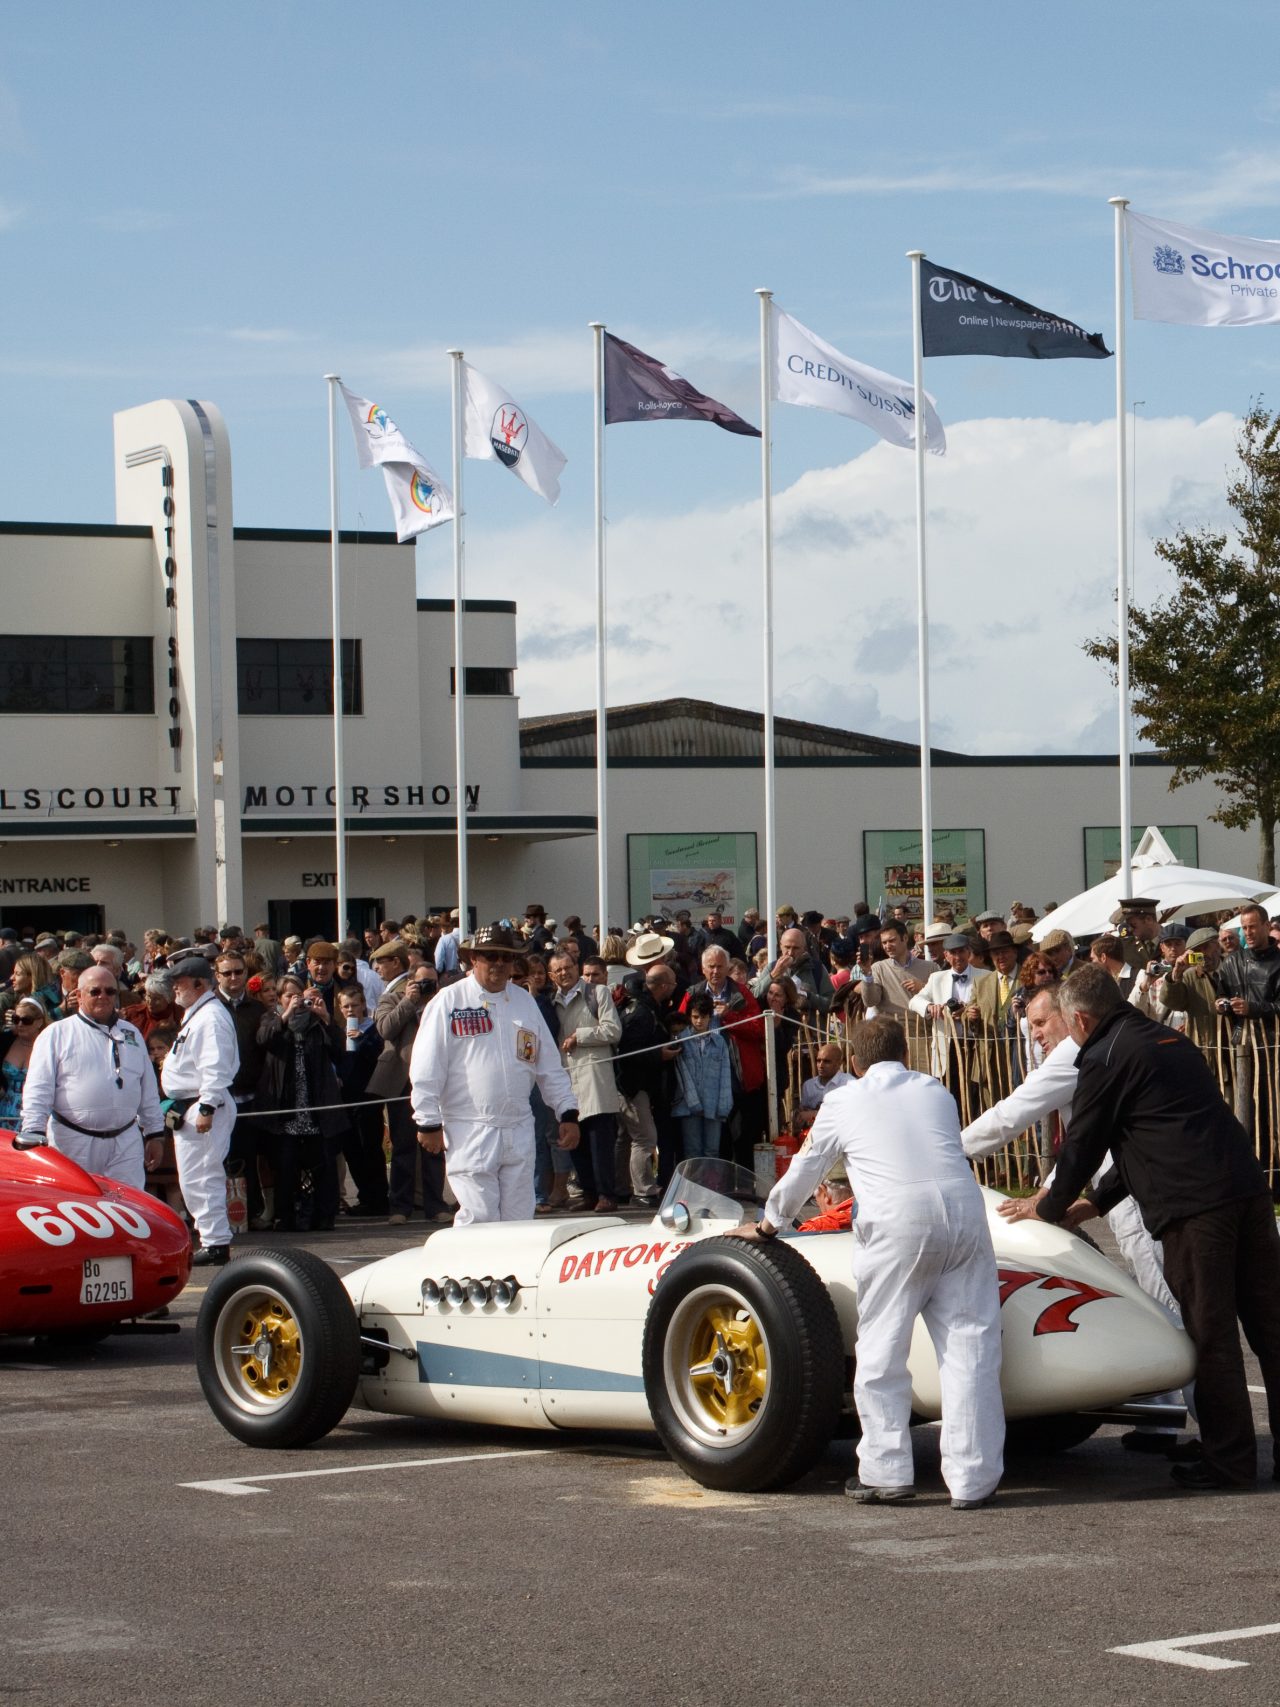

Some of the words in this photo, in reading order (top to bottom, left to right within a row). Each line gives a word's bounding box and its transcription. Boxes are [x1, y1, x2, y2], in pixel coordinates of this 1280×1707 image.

[929, 276, 978, 303] The
[1231, 284, 1277, 297] Private
[959, 315, 988, 326] Online
[996, 317, 1051, 331] Newspapers
[787, 354, 854, 390] CREDIT
[161, 466, 178, 610] MOTOR
[168, 636, 182, 749] SHOW
[57, 786, 182, 809] COURT
[246, 785, 369, 807] MOTOR
[383, 784, 480, 806] SHOW
[302, 872, 338, 888] EXIT
[887, 887, 924, 896] ANGLI
[454, 1009, 486, 1019] KURTIS
[16, 1201, 151, 1246] 600
[84, 1259, 100, 1278] Bo
[559, 1241, 670, 1283] DAYTON
[85, 1281, 127, 1303] 62295
